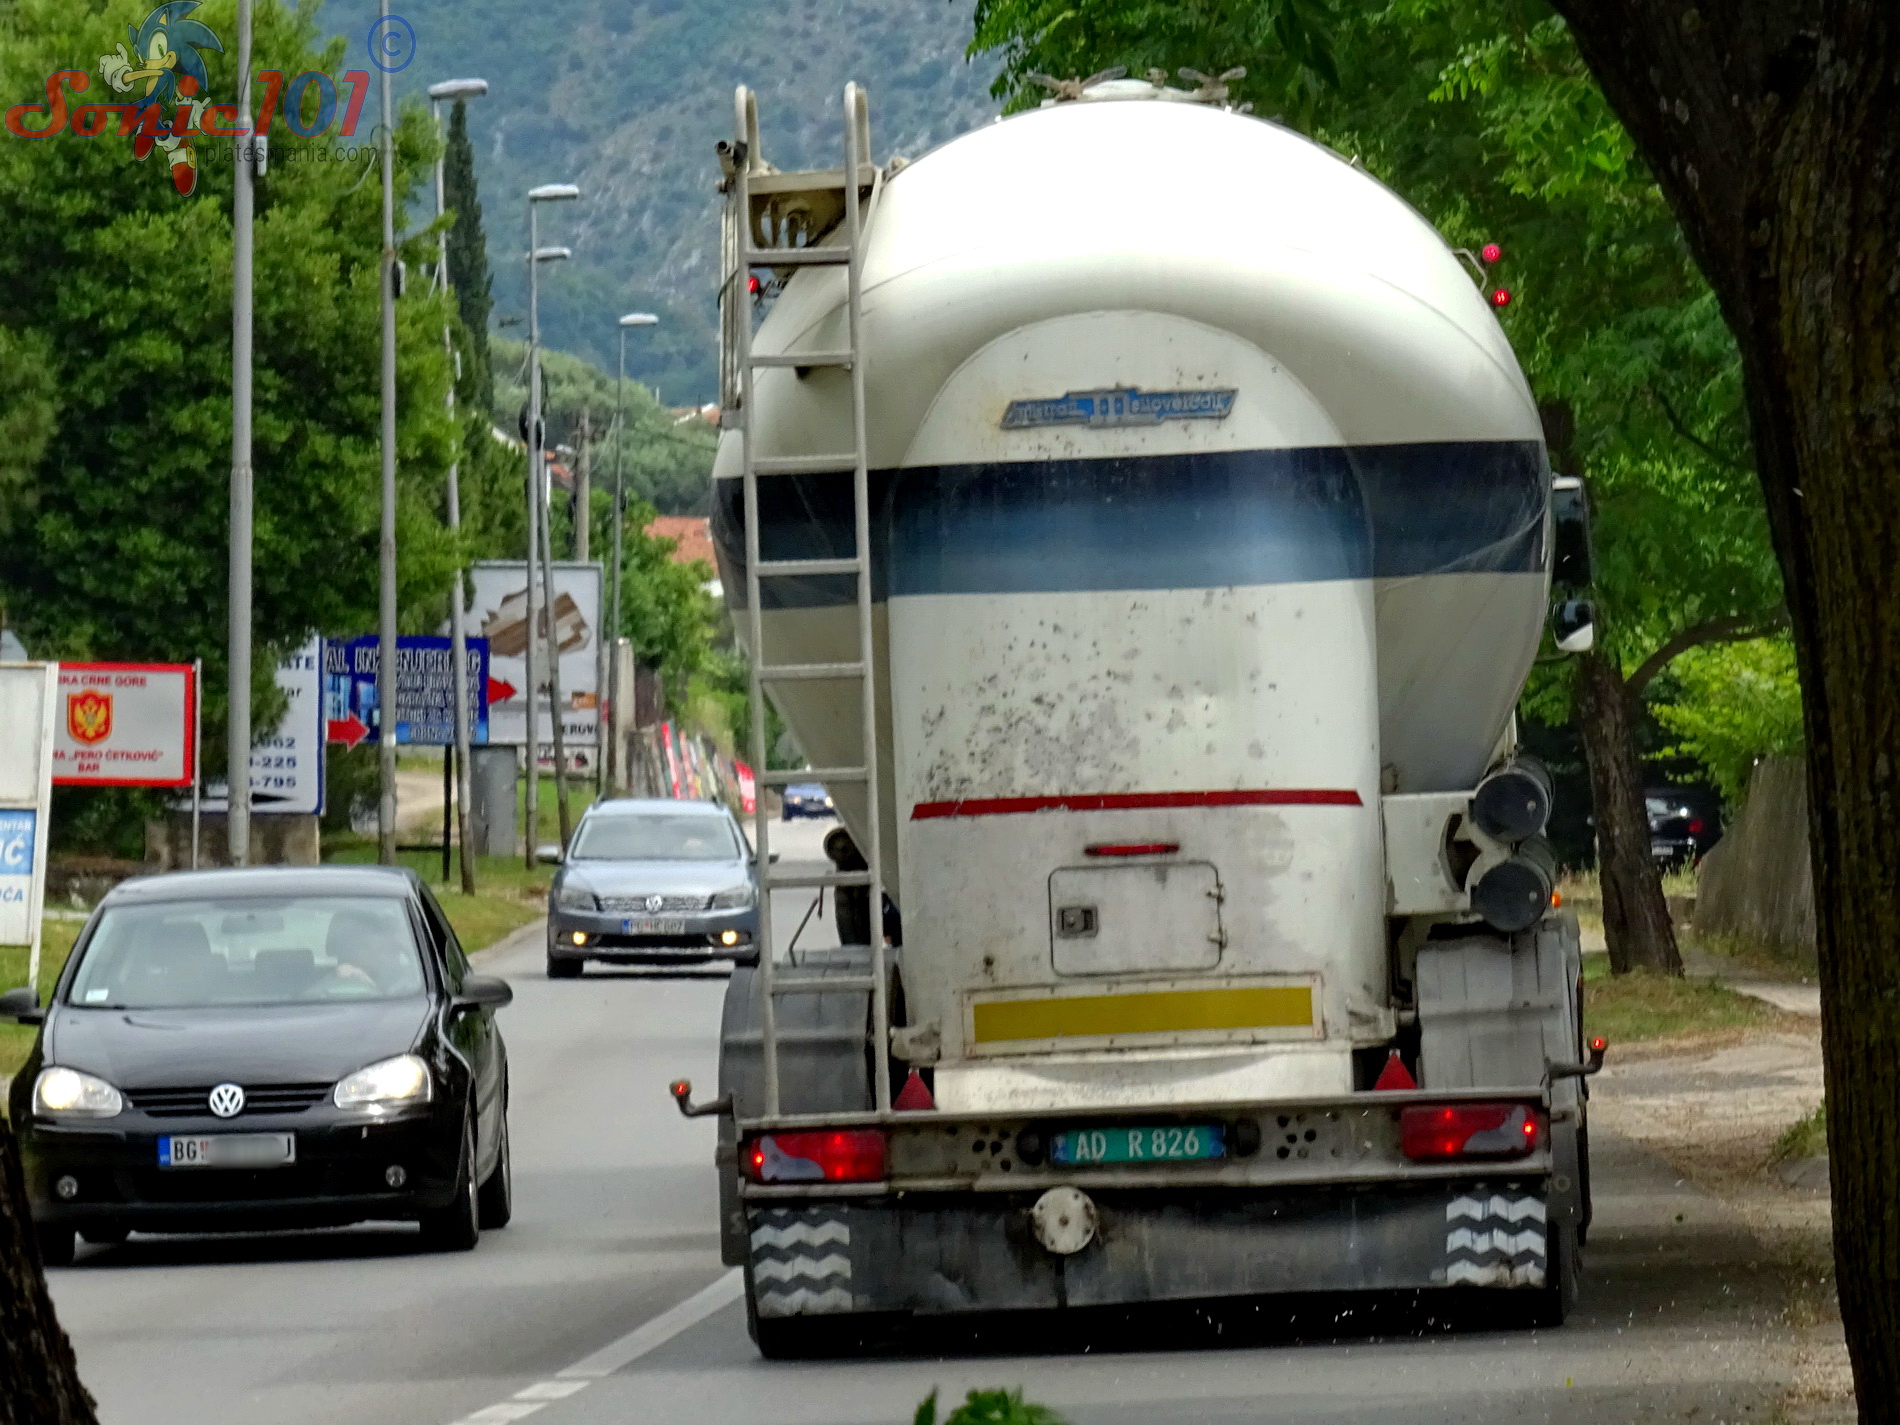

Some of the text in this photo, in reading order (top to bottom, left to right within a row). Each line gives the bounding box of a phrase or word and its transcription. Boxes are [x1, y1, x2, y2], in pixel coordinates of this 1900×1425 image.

[81, 675, 111, 685] CRNE
[115, 676, 147, 687] GORE
[78, 762, 100, 773] BAR
[174, 1140, 197, 1161] BG
[1076, 1131, 1106, 1161] AD
